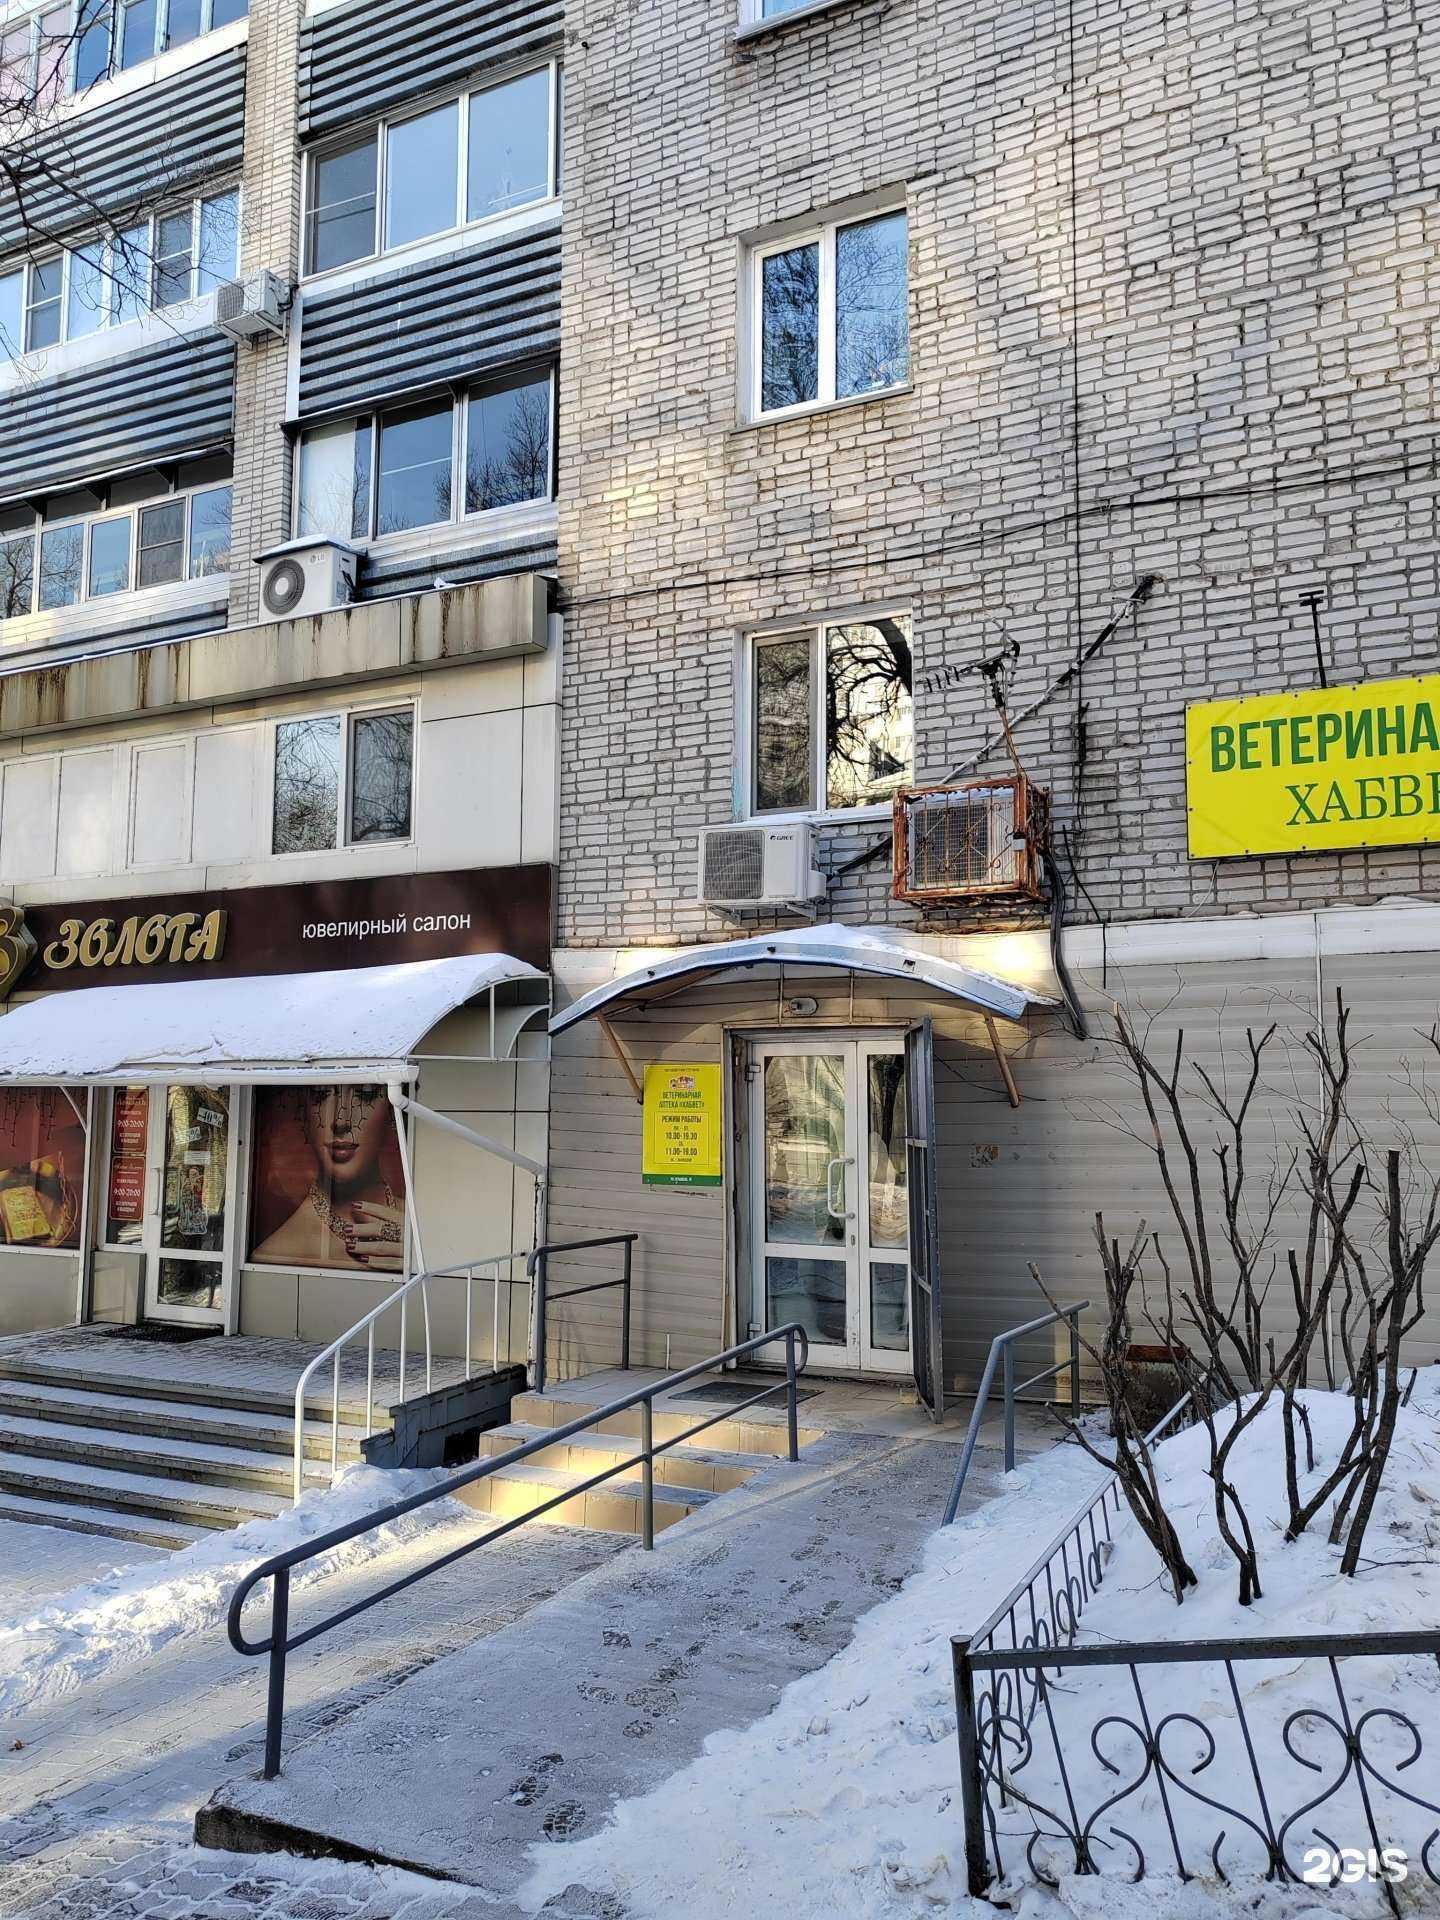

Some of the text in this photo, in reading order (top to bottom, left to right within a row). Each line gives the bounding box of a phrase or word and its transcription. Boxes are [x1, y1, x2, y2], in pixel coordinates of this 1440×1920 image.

[1210, 702, 1440, 773] ВЕТЕРИНА
[44, 910, 226, 969] ЗОЛОТА
[302, 913, 471, 940] ювелирный салон
[662, 1115, 701, 1123] РЕЖИМ РАБОТЫ
